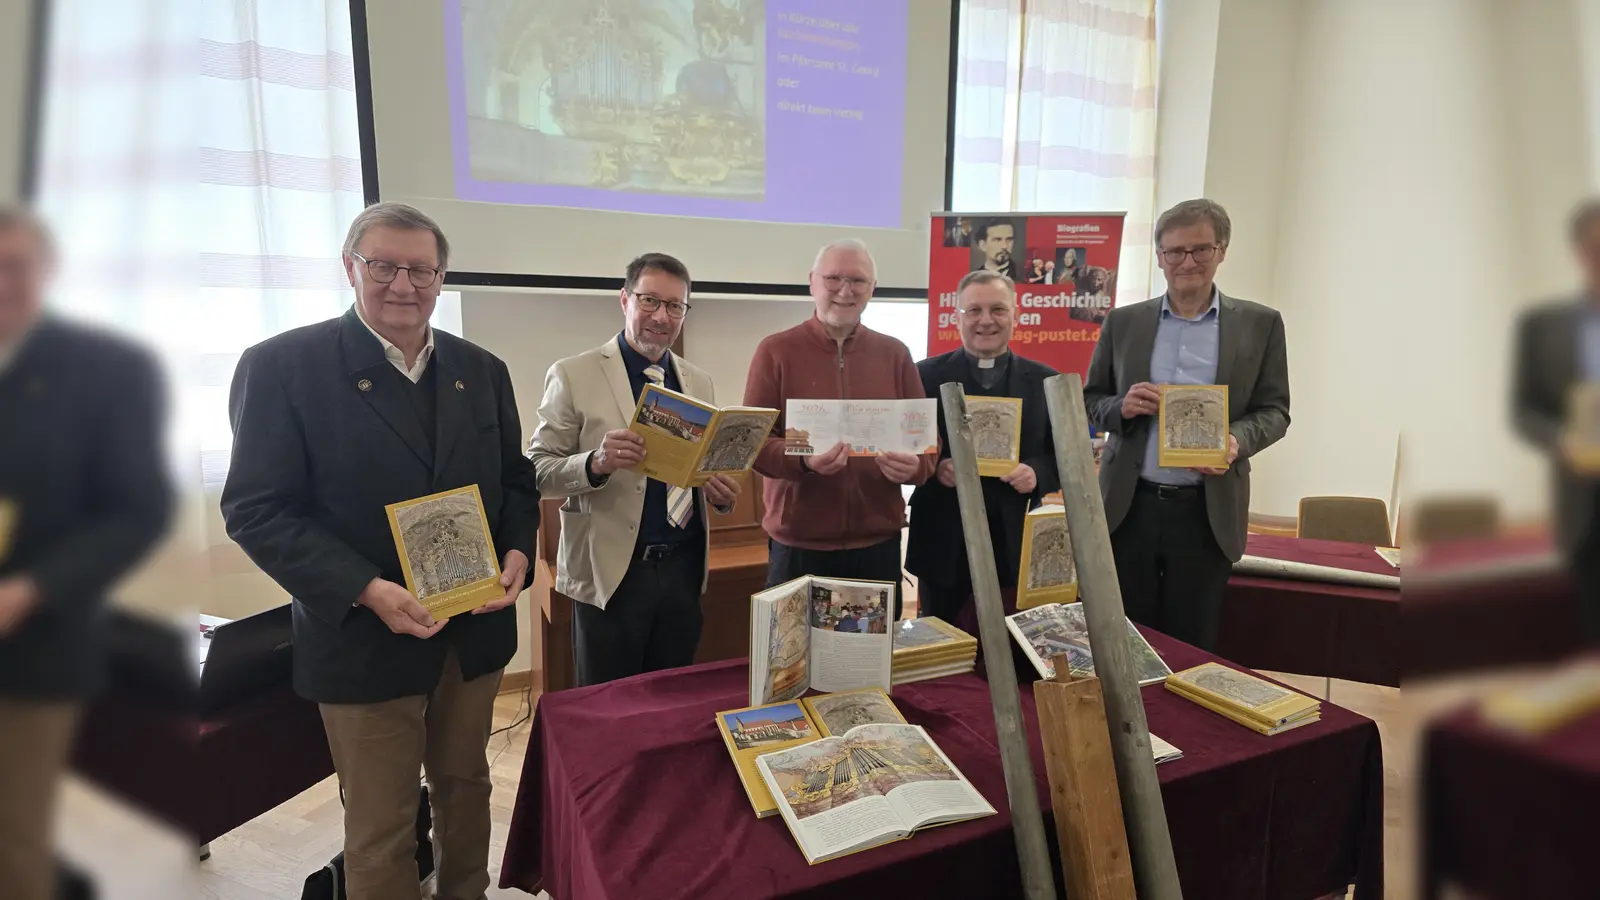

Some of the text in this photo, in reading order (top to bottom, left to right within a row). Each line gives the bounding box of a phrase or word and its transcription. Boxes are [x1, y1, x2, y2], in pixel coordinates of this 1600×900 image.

[777, 77, 800, 89] oder
[1057, 224, 1100, 234] Biografien
[1021, 292, 1111, 308] Geschichte
